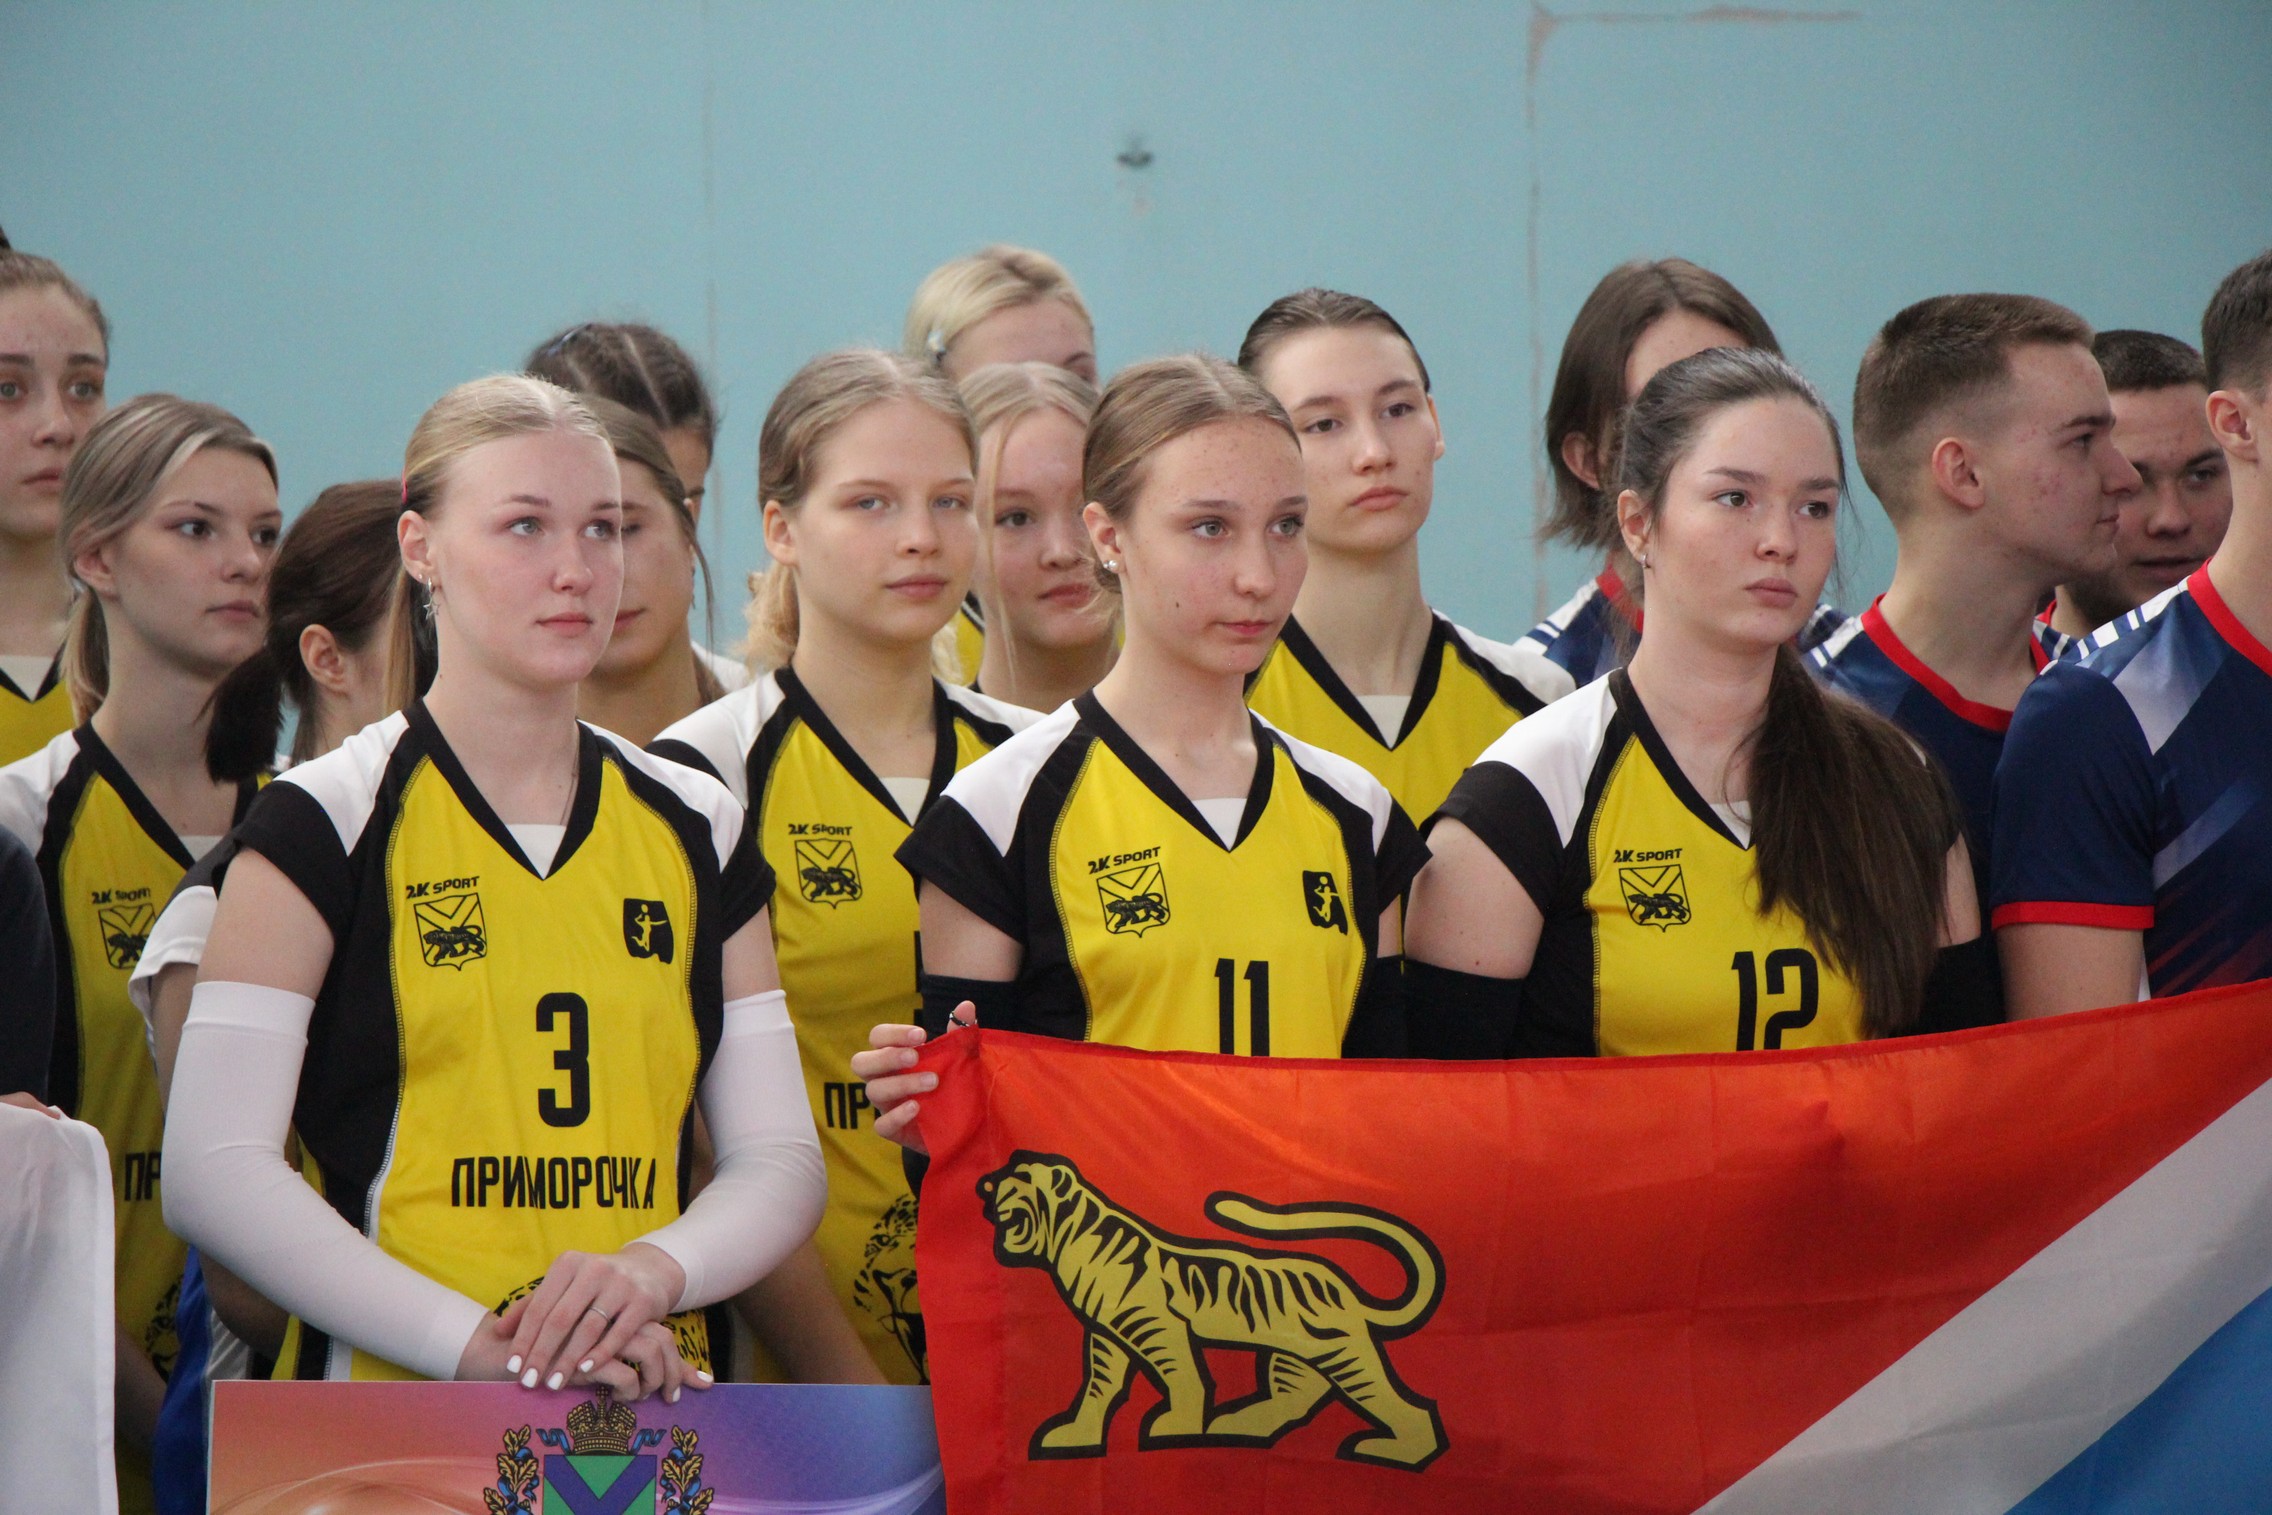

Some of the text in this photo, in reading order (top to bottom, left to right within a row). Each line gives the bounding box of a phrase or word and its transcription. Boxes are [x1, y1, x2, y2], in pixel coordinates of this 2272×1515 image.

[788, 824, 809, 835] 2K
[1088, 846, 1161, 875] 2K SPORT
[1613, 848, 1683, 863] 2K SPORT
[91, 889, 112, 904] 2K
[406, 876, 480, 899] 2K SPORT
[1214, 958, 1270, 1057] 11
[1731, 948, 1819, 1052] 12
[536, 992, 590, 1127] 3
